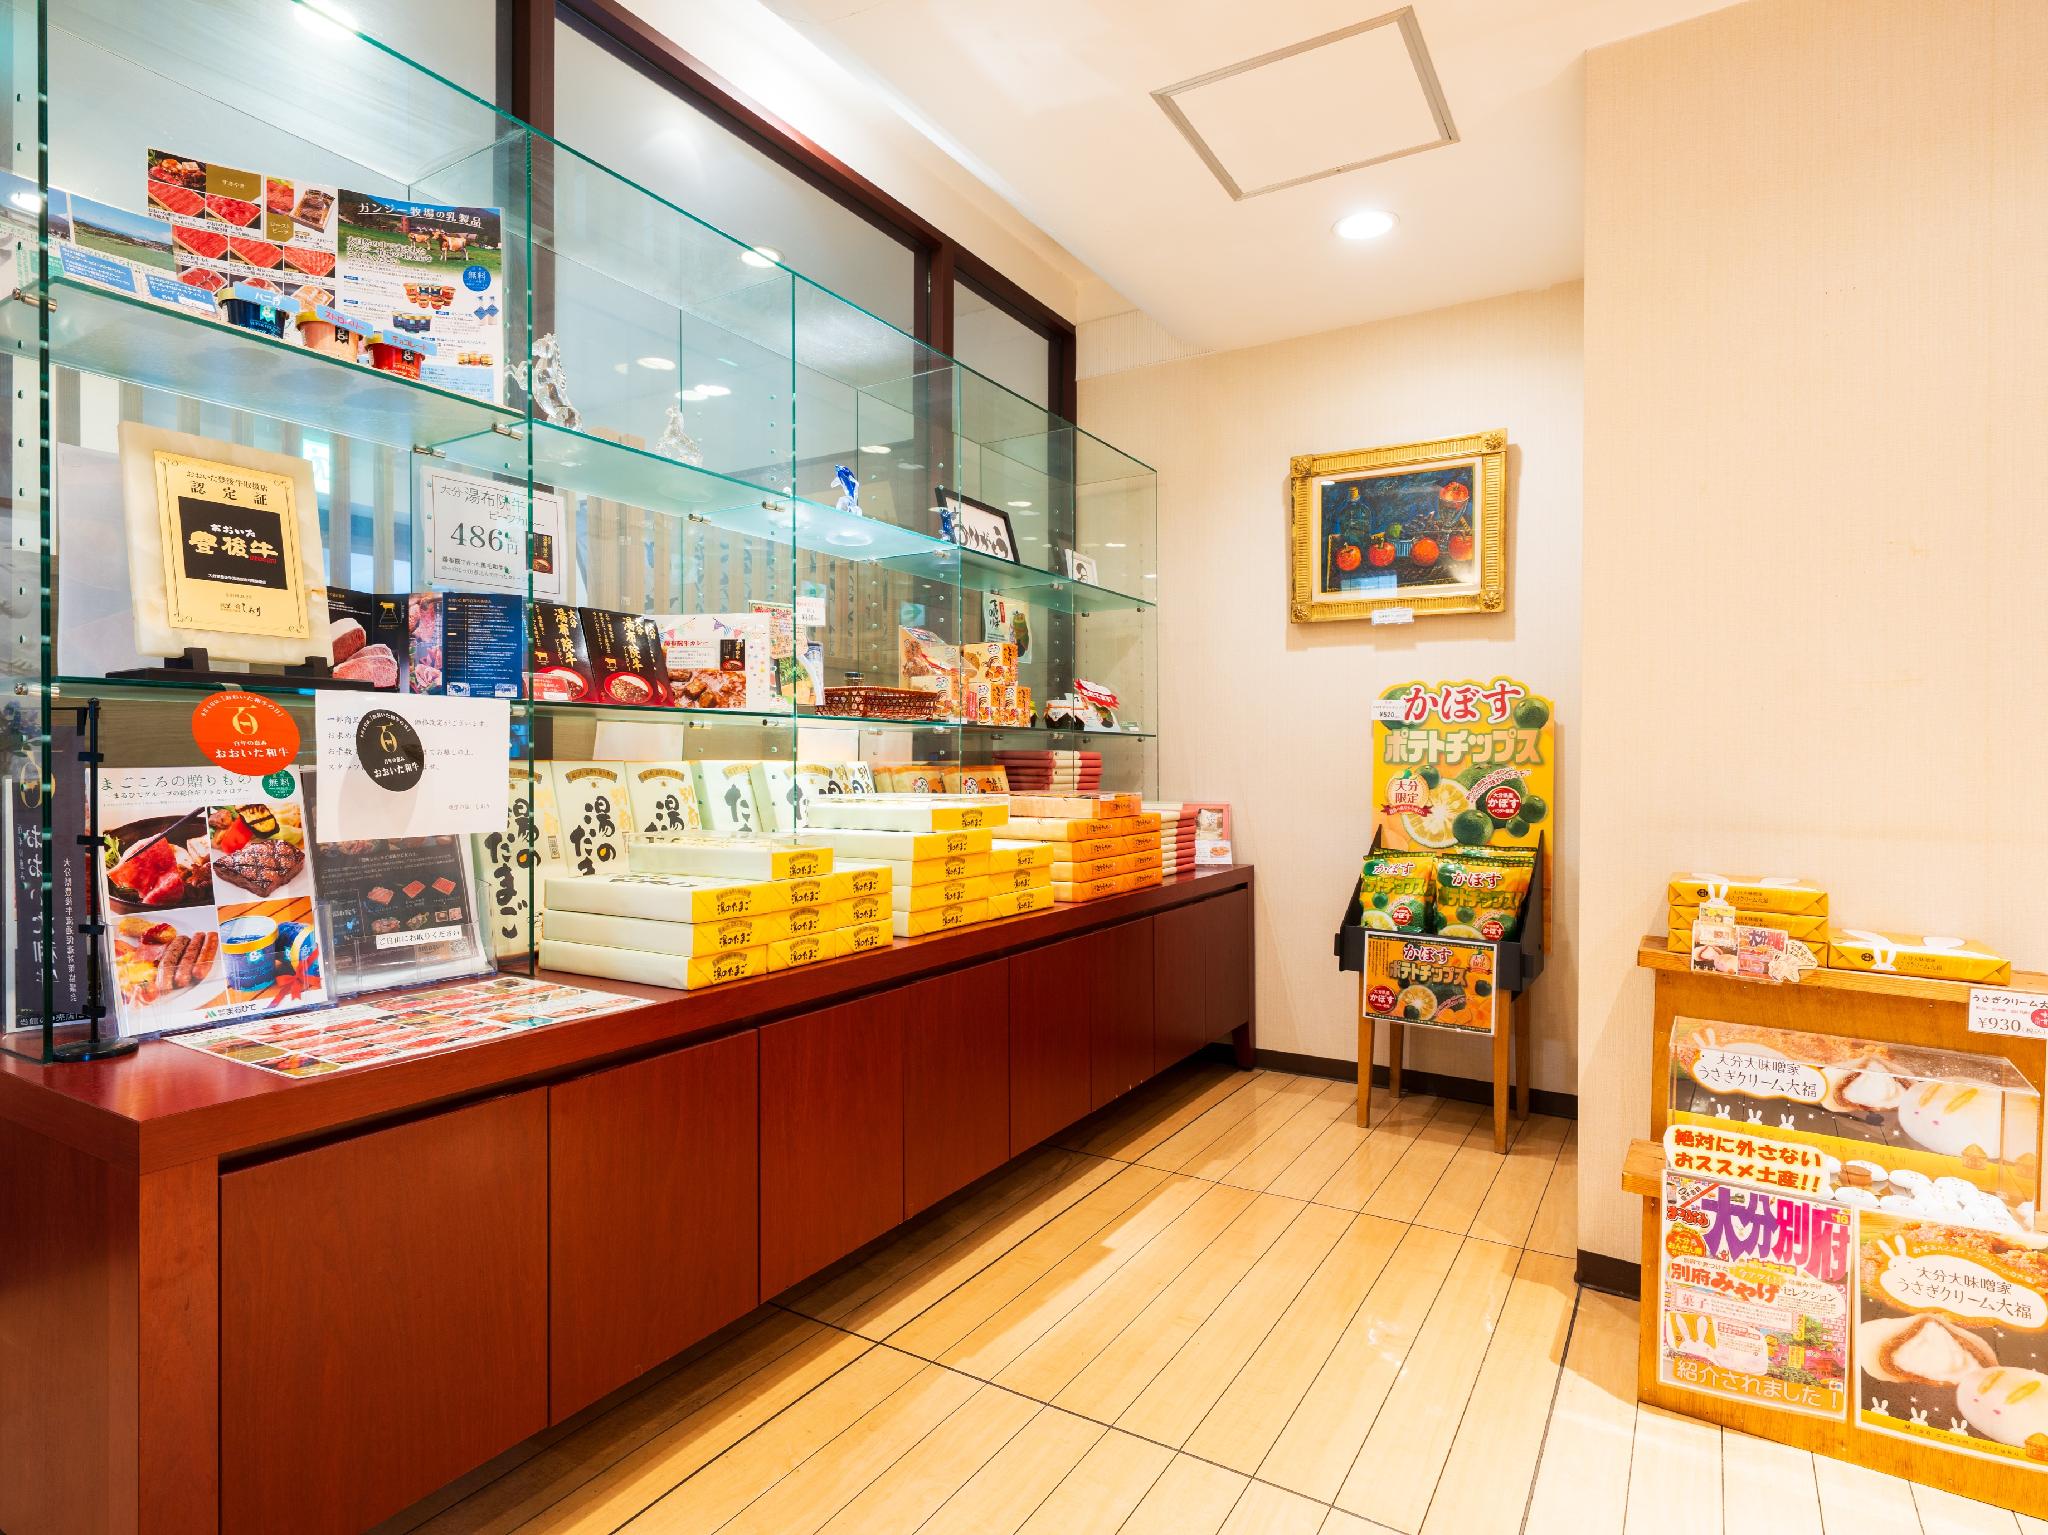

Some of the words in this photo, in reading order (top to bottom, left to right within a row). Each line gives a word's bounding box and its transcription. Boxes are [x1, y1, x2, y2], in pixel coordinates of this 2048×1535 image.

[358, 202, 483, 228] ガンジー牧場の乳製品
[209, 523, 256, 538] おおいた
[1403, 681, 1524, 723] かぼす
[1379, 711, 1396, 719] ¥520
[215, 746, 289, 758] おおいた和牛
[1384, 729, 1543, 765] ポテトチップス
[373, 762, 420, 778] おおいた和牛
[1395, 780, 1419, 792] 大分
[1395, 792, 1419, 804] 限定
[1487, 798, 1520, 809] かぼす
[1372, 862, 1416, 876] かぼす
[1451, 872, 1502, 889] かぼす
[379, 930, 461, 946] ご自由にお取りください
[1403, 944, 1453, 964] かぼす
[1389, 960, 1468, 987] ポテトチップス
[1369, 994, 1395, 1005] かぼす
[1977, 1017, 2022, 1034] ¥930
[1717, 1052, 1801, 1076] 大分大味噌家
[1699, 1064, 1818, 1098] うさぎクリーム大福
[1674, 1128, 1822, 1168] 絶対に外さない
[1674, 1152, 1821, 1193] おススメ土産!!
[1701, 1186, 1851, 1281] 大分別府
[1670, 1263, 1779, 1303] 別府みやげ
[1916, 1266, 2013, 1296] 大分大味噌家
[1784, 1288, 1838, 1302] セレクション
[1897, 1276, 2033, 1320] うさぎクリーム大福
